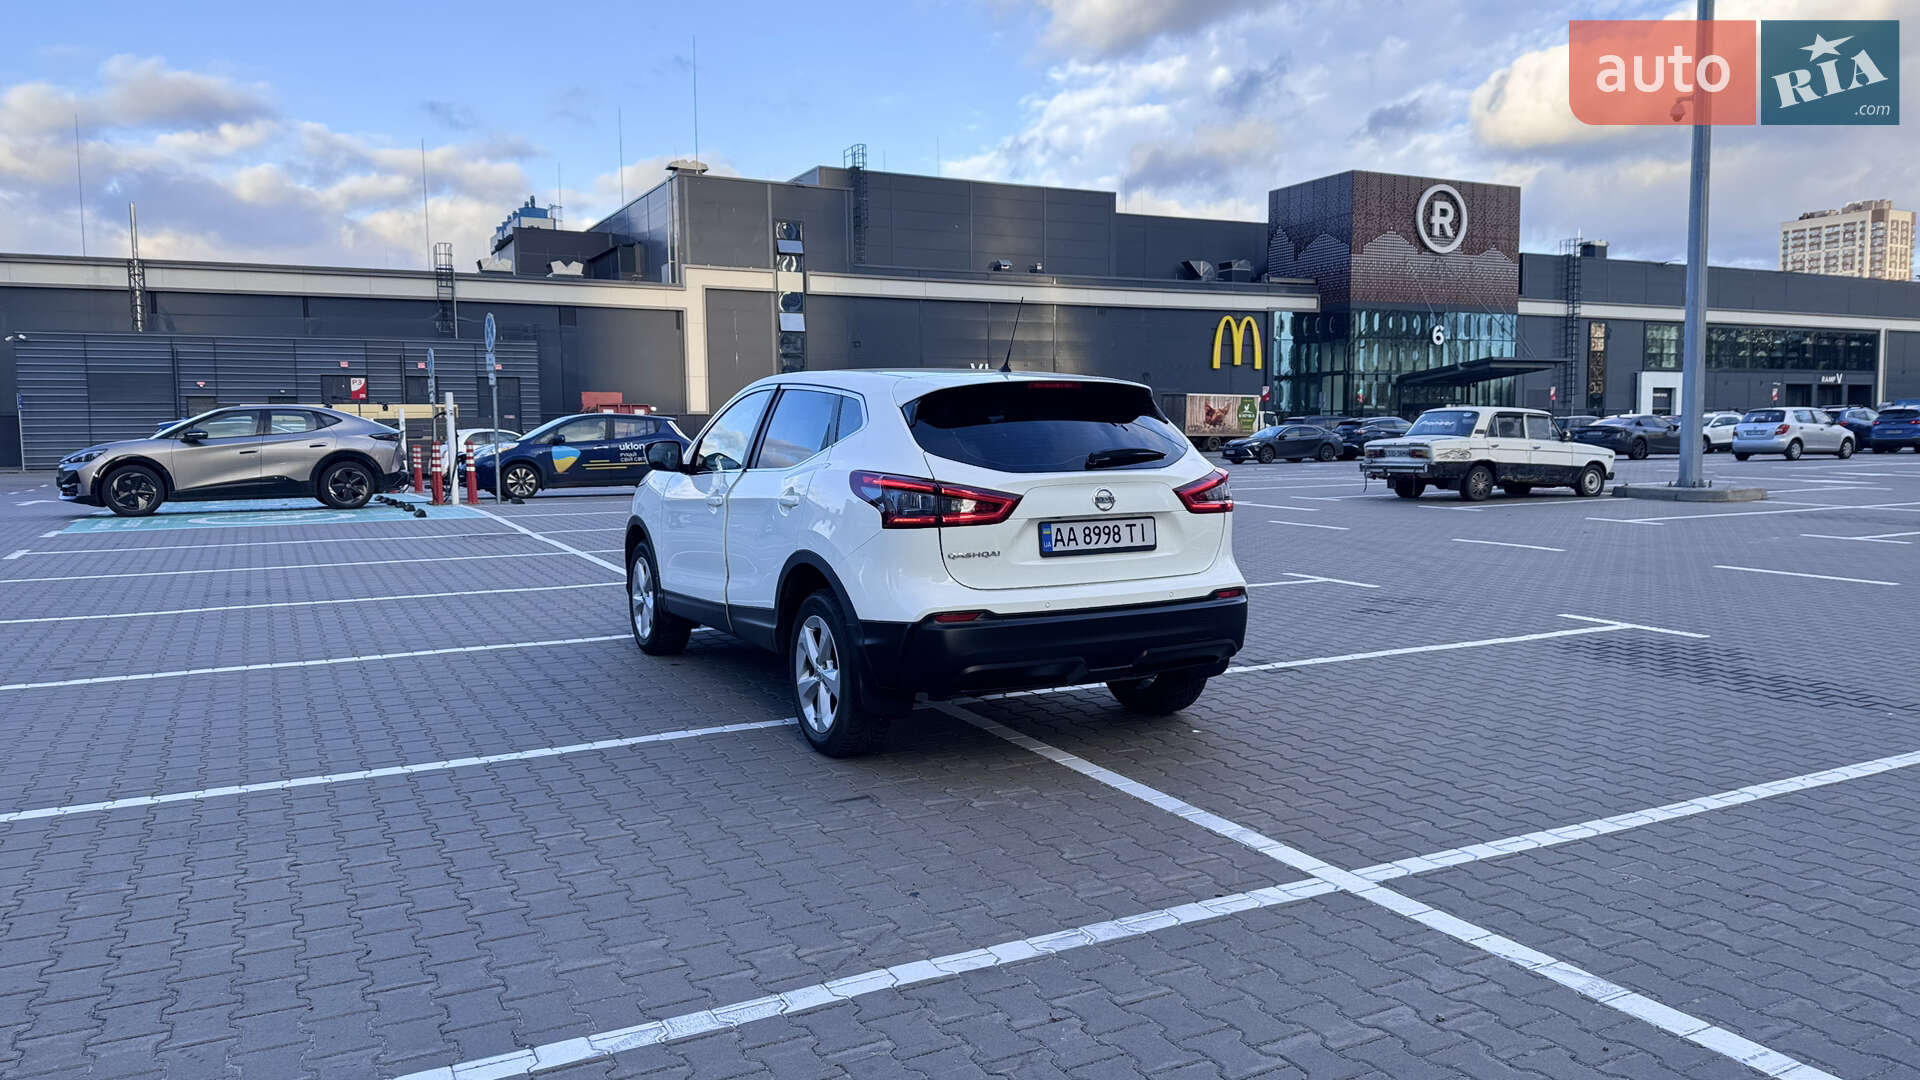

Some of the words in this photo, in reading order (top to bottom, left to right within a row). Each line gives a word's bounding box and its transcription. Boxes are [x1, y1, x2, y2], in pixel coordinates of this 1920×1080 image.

[1432, 324, 1445, 346] 6
[619, 442, 646, 450] uklon
[1053, 526, 1079, 548] AA
[1082, 524, 1122, 546] 8998
